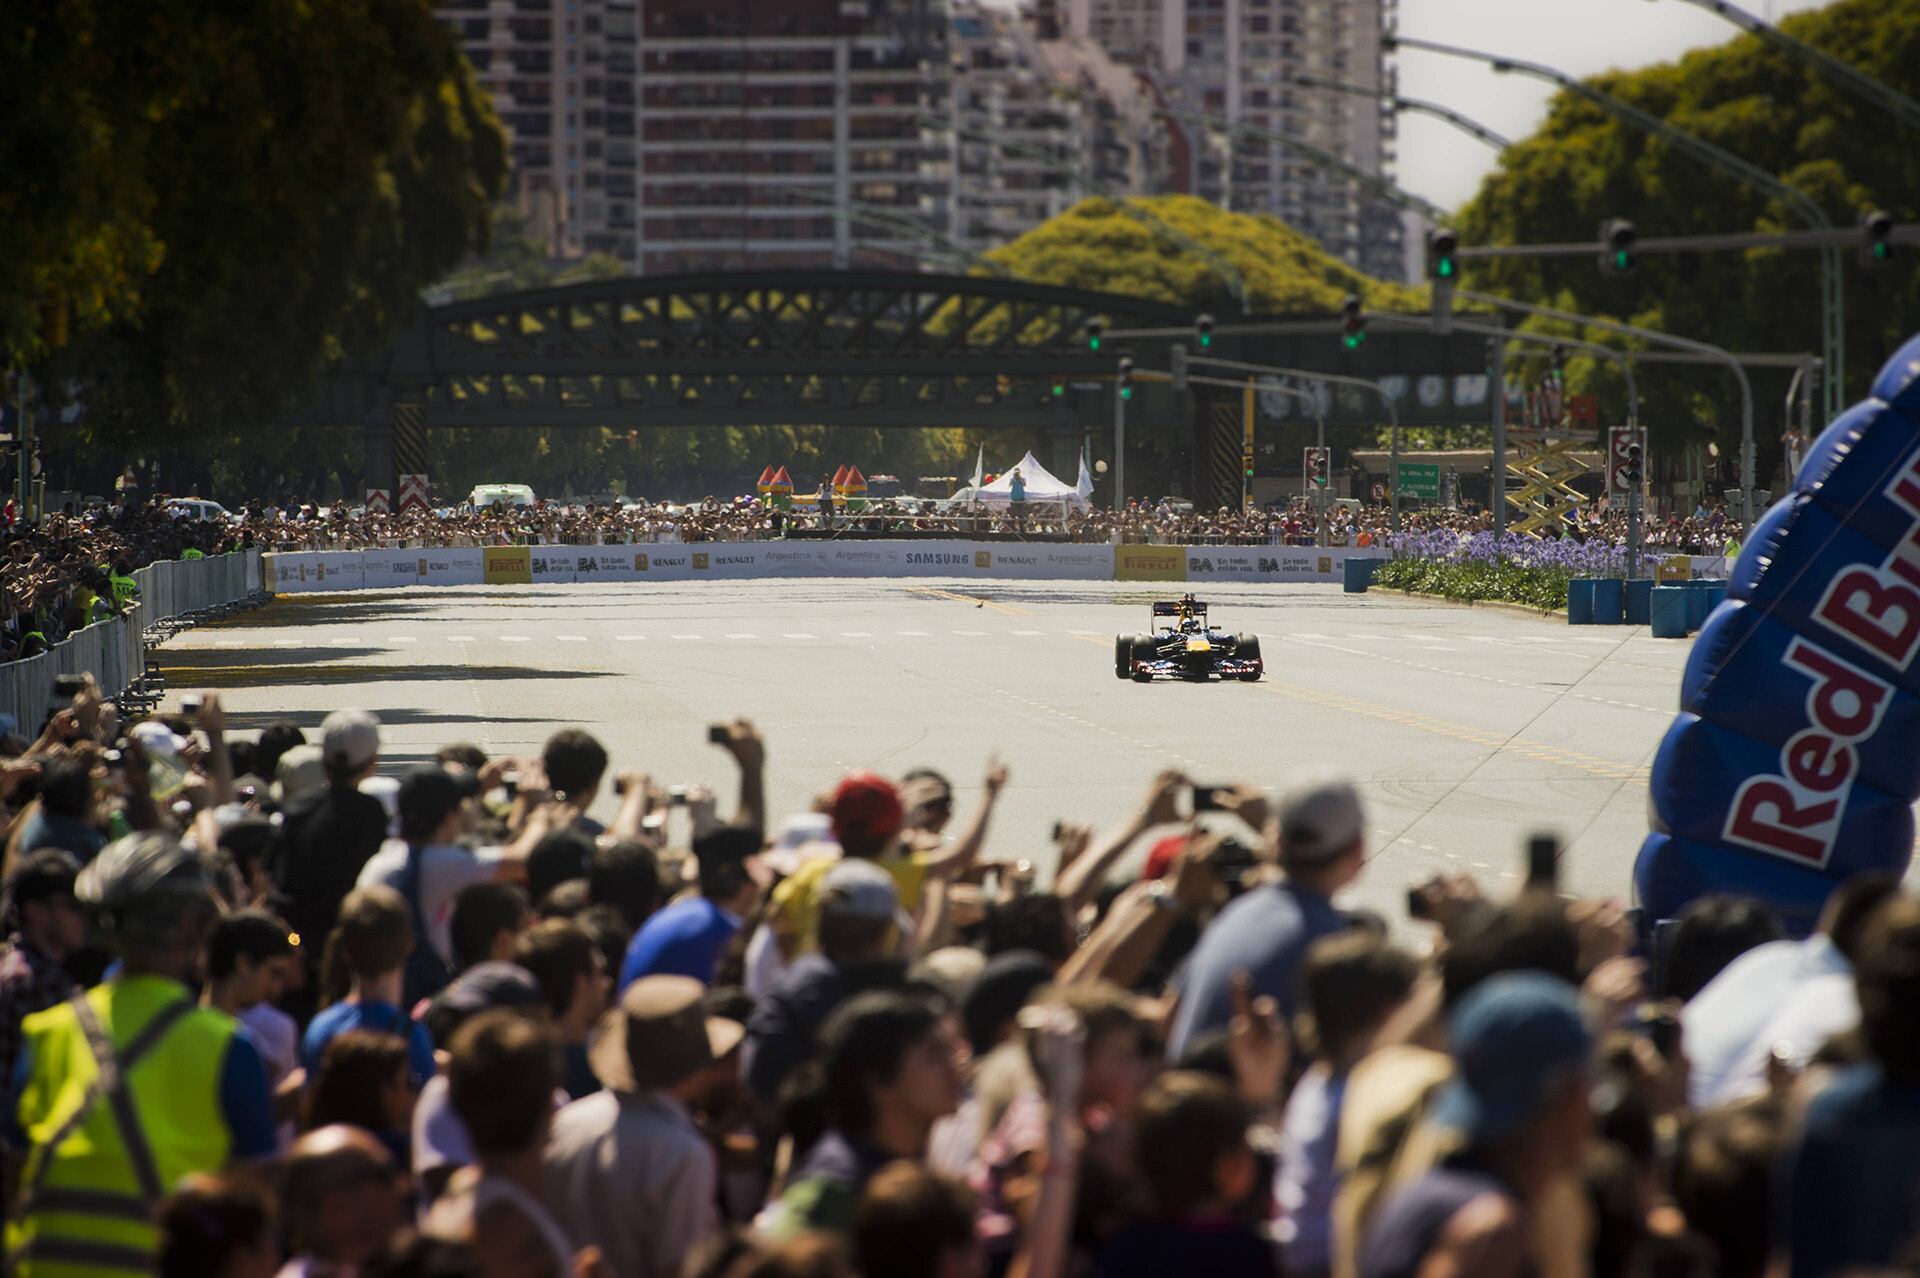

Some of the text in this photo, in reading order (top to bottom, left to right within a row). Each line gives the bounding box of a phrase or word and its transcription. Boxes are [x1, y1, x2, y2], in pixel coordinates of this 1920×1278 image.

[715, 556, 755, 565] RENAULT
[766, 551, 811, 561] Argentina
[836, 551, 881, 561] Argentina
[906, 552, 969, 565] SAMSUNG
[998, 556, 1037, 565] RENAULT
[653, 558, 686, 567] RENAULT
[1124, 556, 1178, 570] PIRELLI
[1722, 635, 1897, 870] Red
